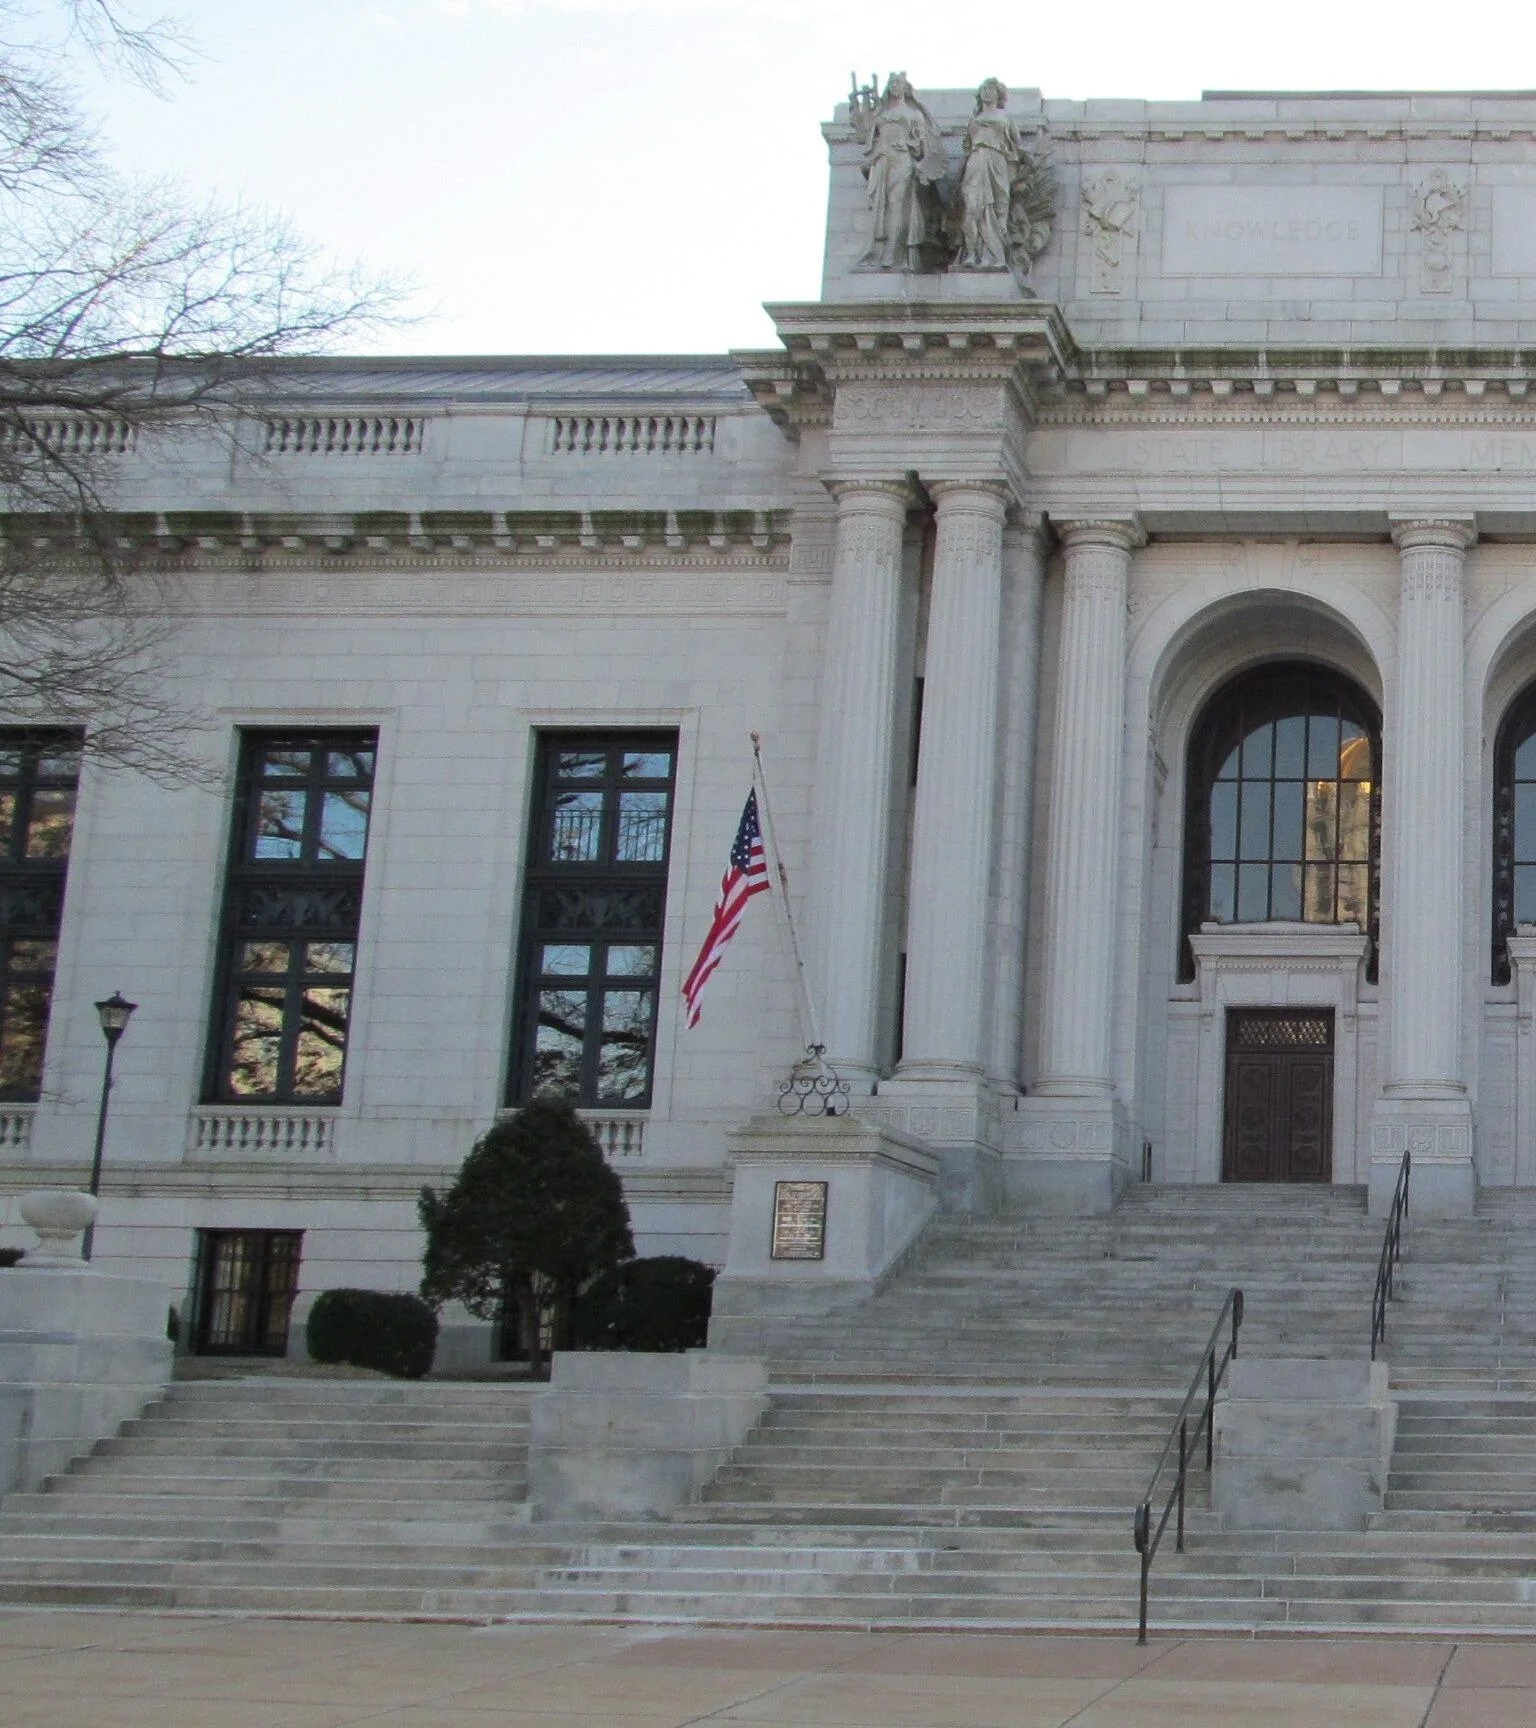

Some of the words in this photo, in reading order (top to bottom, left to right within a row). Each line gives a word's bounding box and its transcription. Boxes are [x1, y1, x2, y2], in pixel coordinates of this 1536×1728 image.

[1185, 219, 1360, 242] KNOWLEDGE
[1131, 437, 1228, 467] STATE
[1250, 437, 1388, 467] LIBRARY
